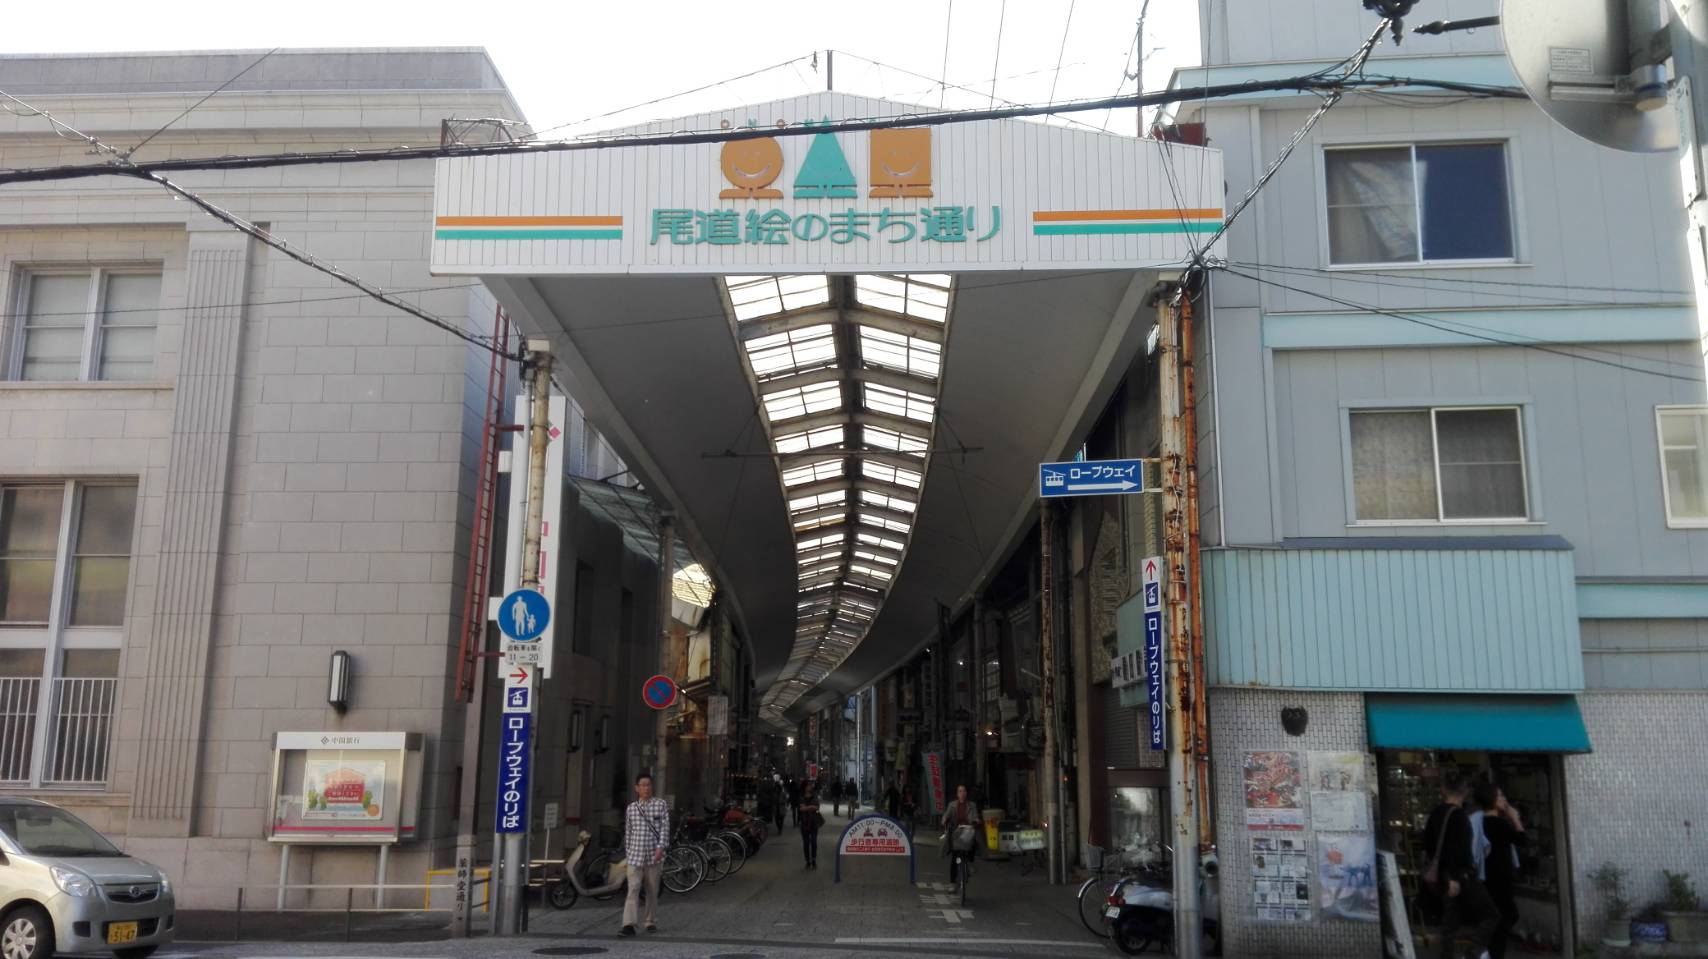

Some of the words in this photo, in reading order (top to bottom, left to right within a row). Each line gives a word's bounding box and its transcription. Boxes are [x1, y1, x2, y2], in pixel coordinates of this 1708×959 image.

[650, 206, 1002, 246] 尾道絵のまち通り
[1069, 464, 1136, 479] ロープウェイ
[1148, 617, 1161, 744] ロープウェイのりば
[502, 716, 524, 829] ロープウェイのりば
